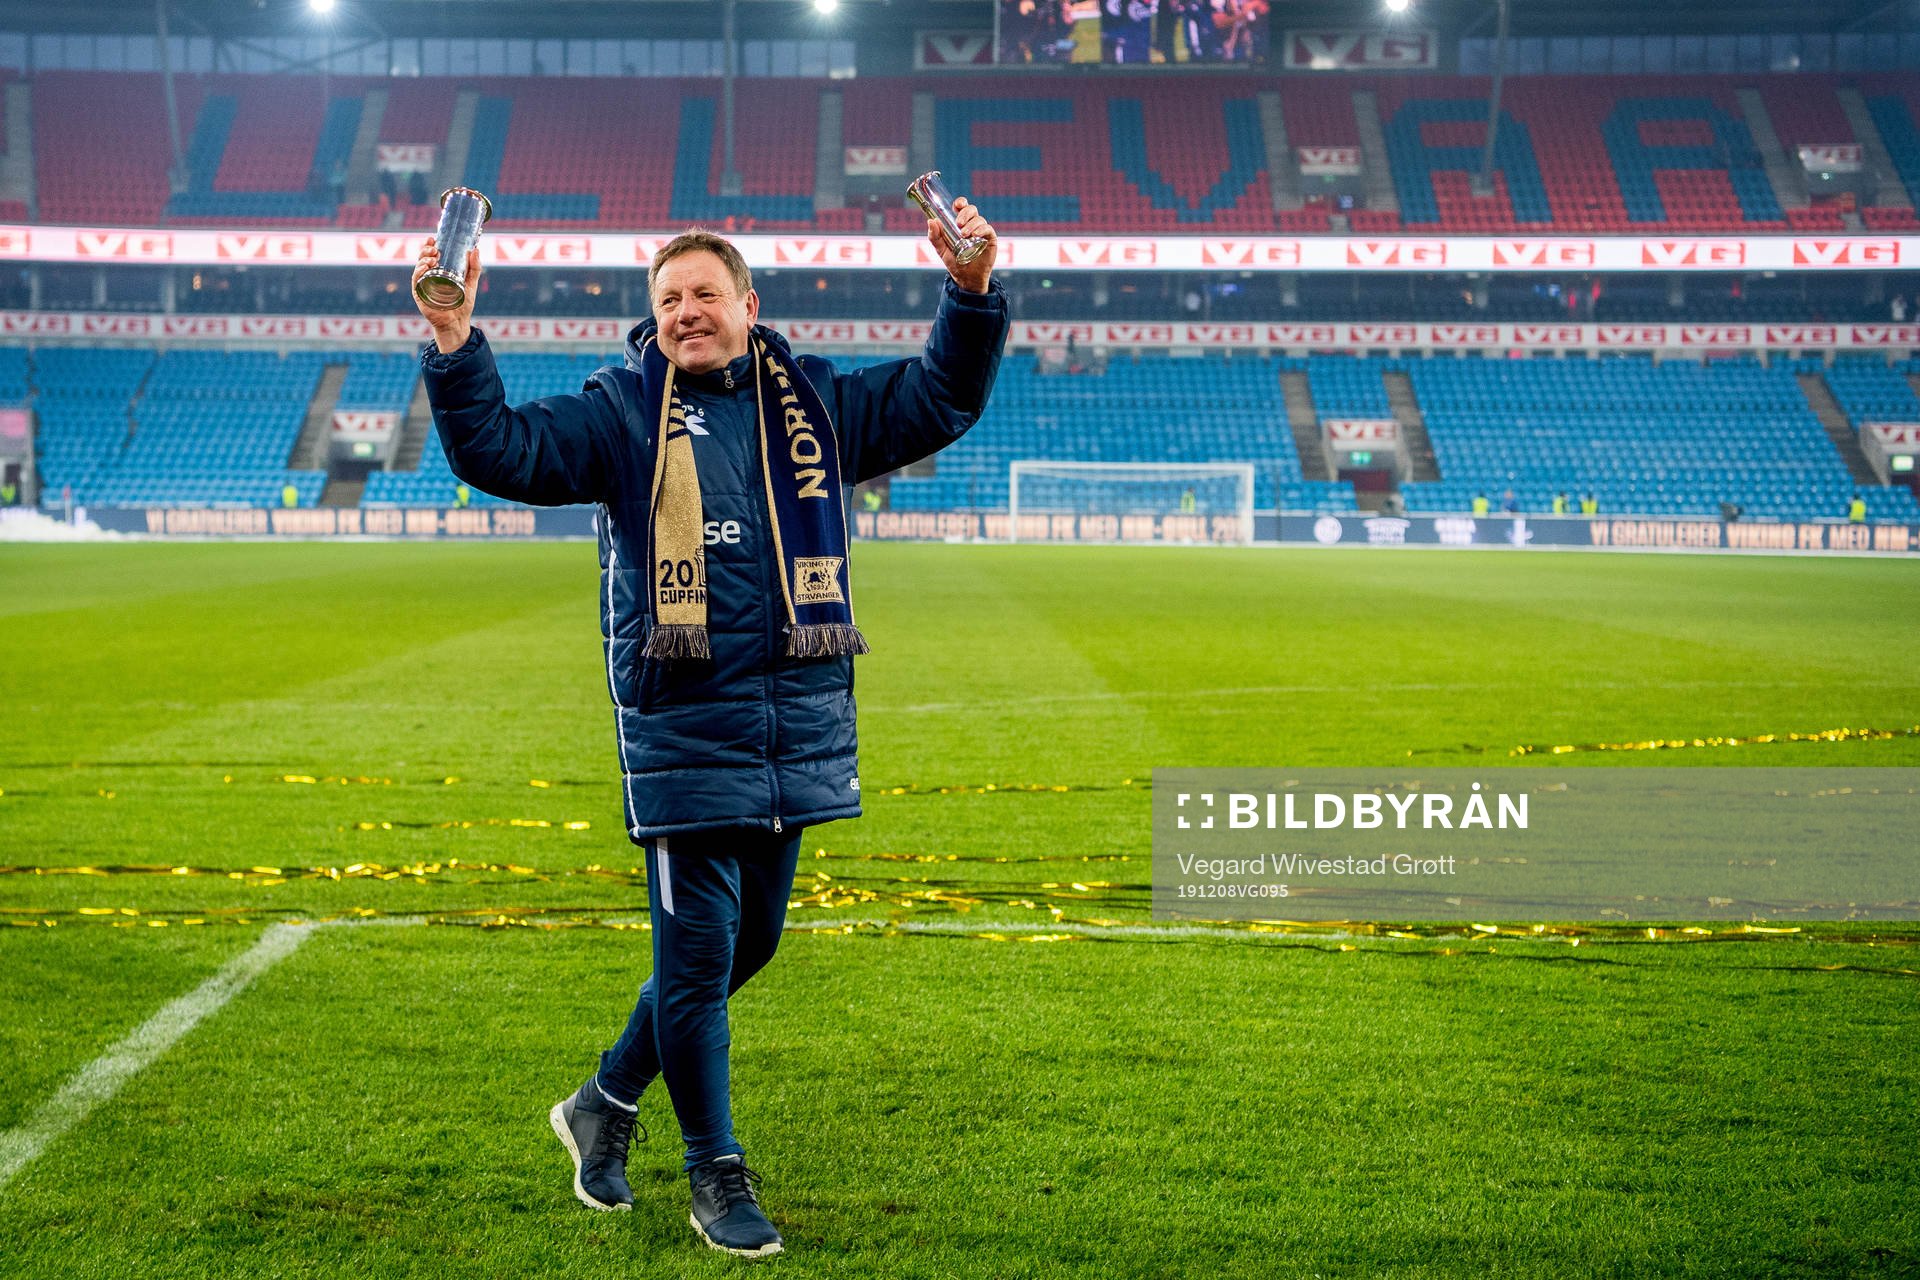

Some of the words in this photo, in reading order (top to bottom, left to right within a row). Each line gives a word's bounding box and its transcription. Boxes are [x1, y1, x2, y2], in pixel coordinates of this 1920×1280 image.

[1291, 35, 1427, 64] VG
[76, 230, 173, 257] VG
[217, 233, 312, 259] VG
[496, 237, 592, 262] VG
[775, 239, 872, 264] VG
[1793, 240, 1900, 265] VG
[1058, 241, 1157, 265] VG
[1202, 241, 1302, 266] VG
[1346, 241, 1447, 266] VG
[1493, 241, 1595, 266] VG
[1641, 241, 1746, 266] VG
[4, 316, 70, 333] VG
[84, 317, 151, 335] VG
[163, 317, 229, 335] VG
[242, 318, 306, 336] VG
[320, 318, 384, 336] VG
[477, 321, 541, 337] VG
[553, 322, 619, 338] VG
[789, 323, 854, 340] VG
[868, 324, 932, 340] VG
[1027, 325, 1093, 342] VG
[1107, 325, 1173, 342] VG
[1188, 325, 1253, 342] VG
[1268, 326, 1335, 343] VG
[1350, 326, 1417, 343] VG
[1431, 326, 1499, 343] VG
[1514, 326, 1582, 344] VG
[1597, 326, 1666, 344] VG
[1681, 326, 1752, 344] VG
[1766, 326, 1837, 344] VG
[1852, 326, 1920, 344] VG
[332, 412, 398, 431] VG
[1328, 421, 1397, 440] VG
